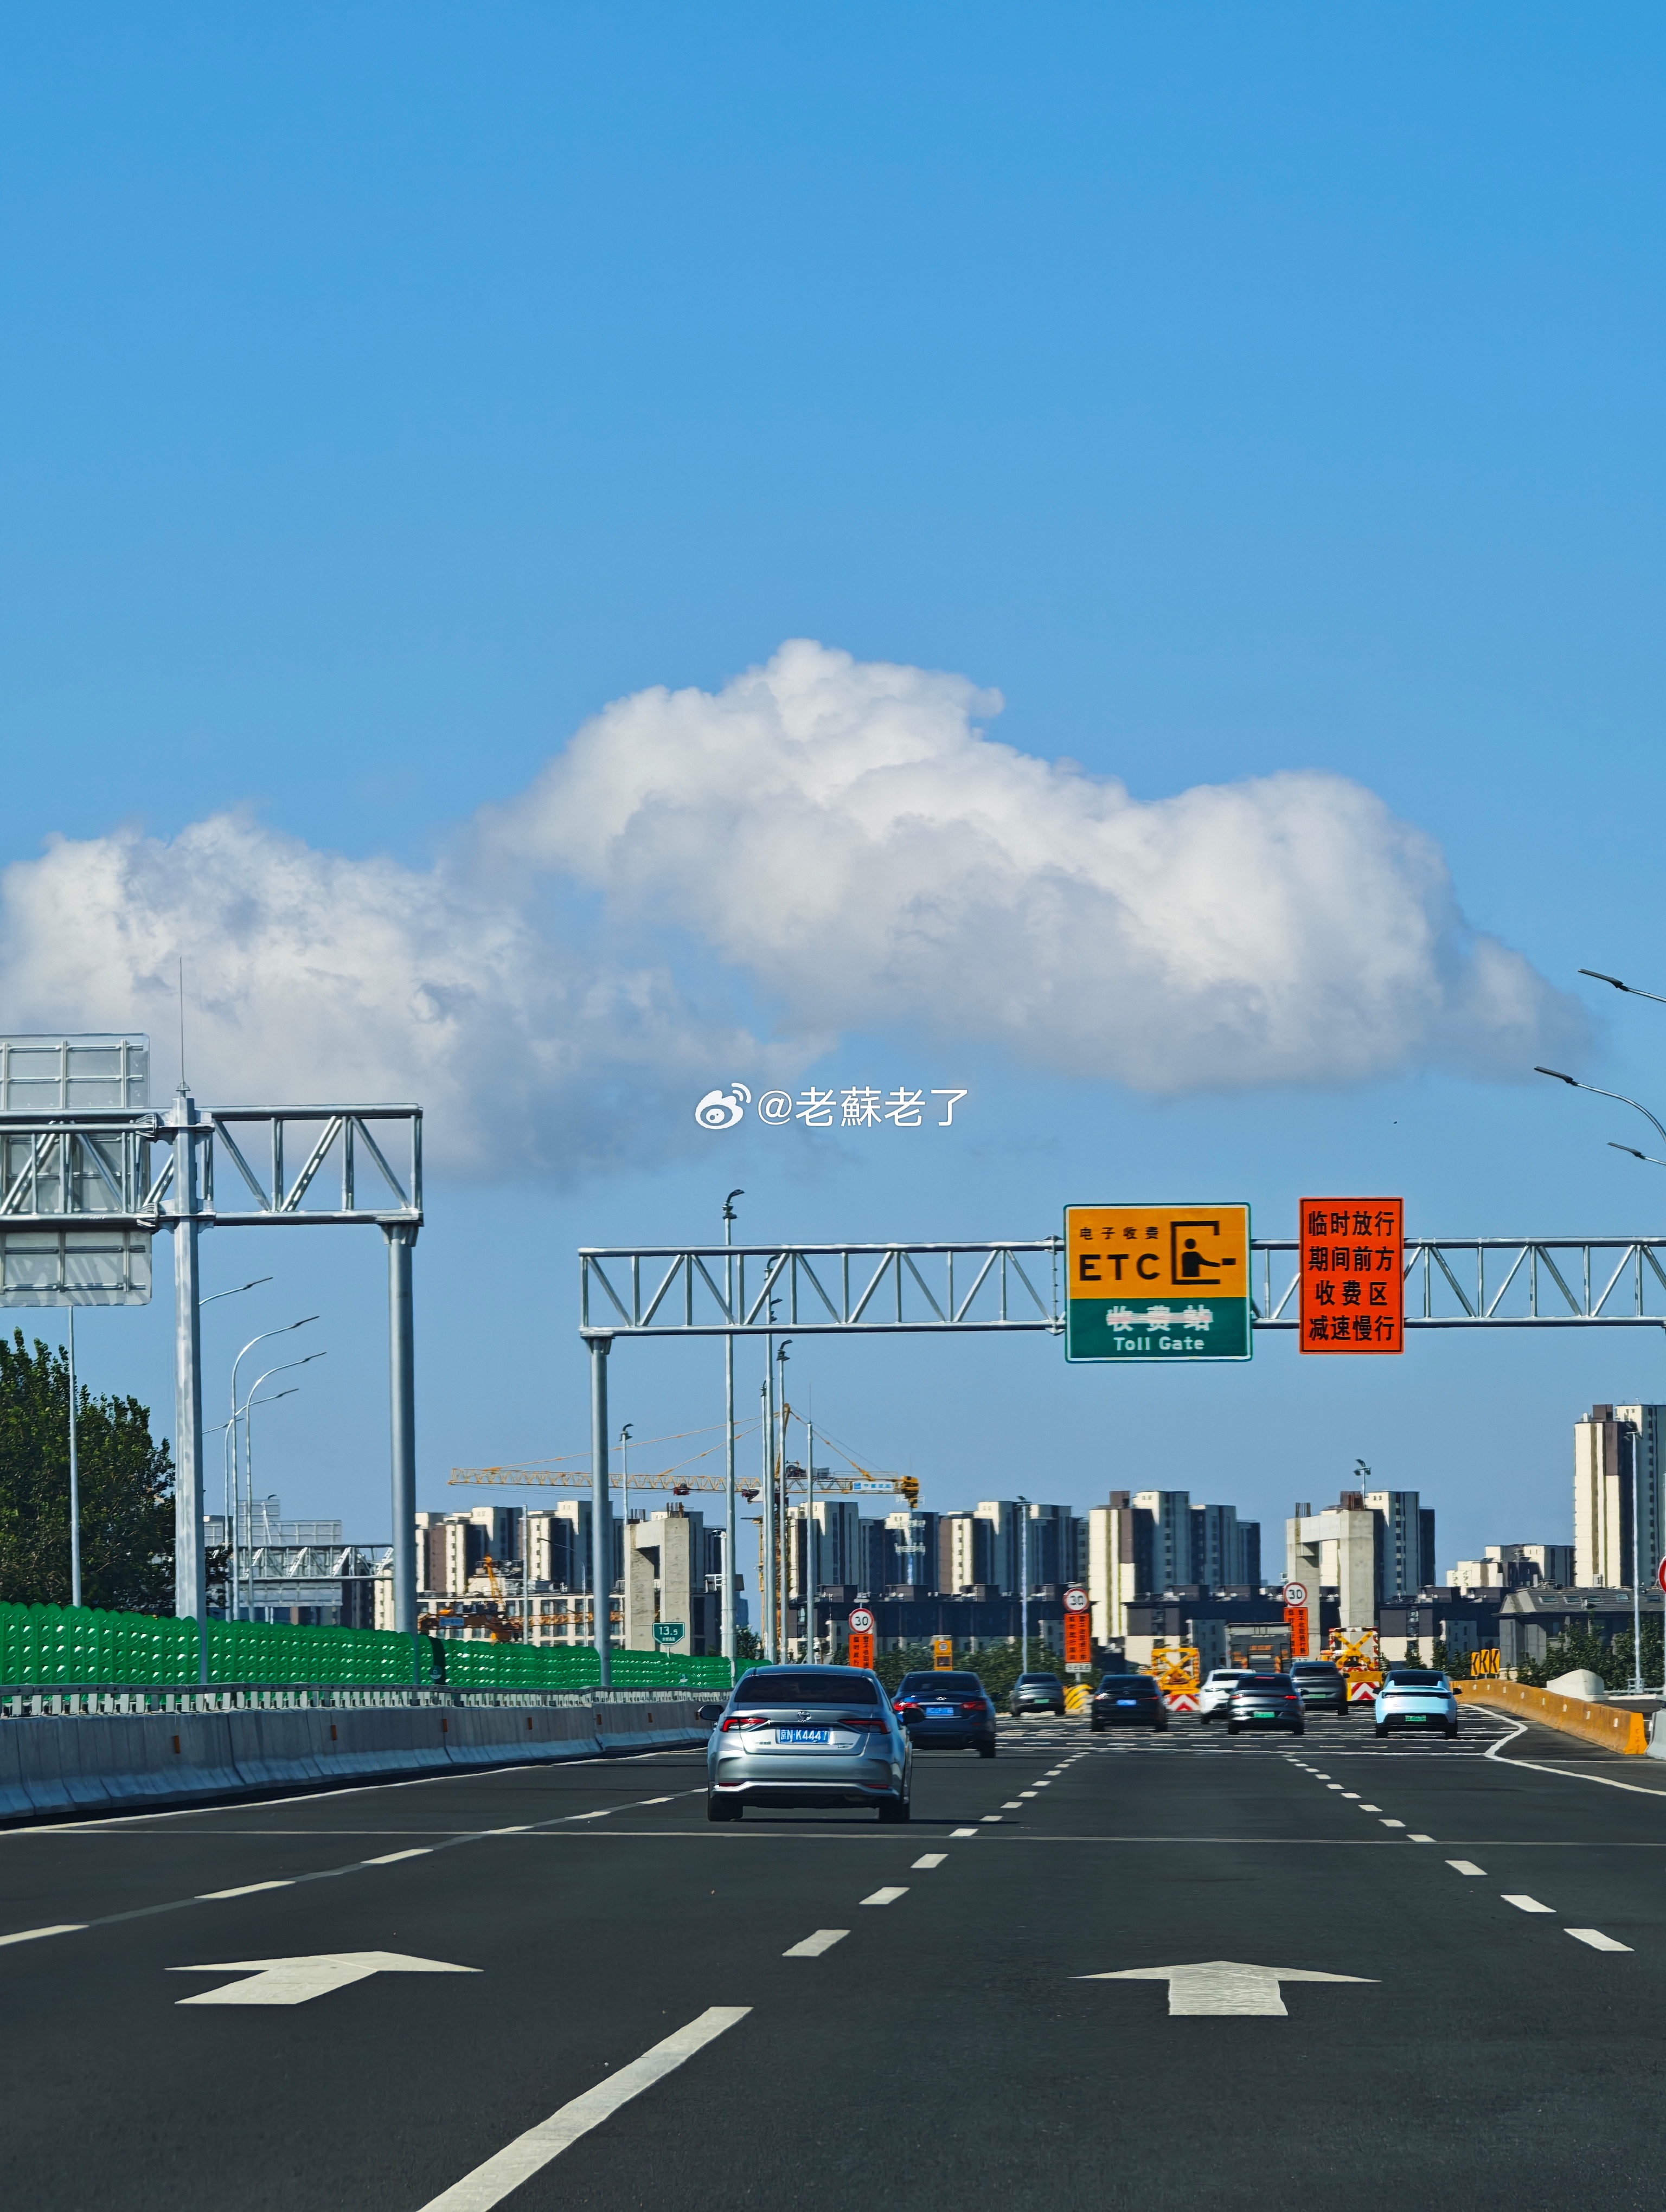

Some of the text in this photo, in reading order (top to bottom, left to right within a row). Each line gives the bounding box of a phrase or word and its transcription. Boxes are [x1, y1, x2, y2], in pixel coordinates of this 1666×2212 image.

[1308, 1210, 1395, 1237] 临时放行
[1079, 1226, 1159, 1240] 电子收费
[1308, 1245, 1395, 1272] 期间前方
[1079, 1253, 1161, 1281] ETC
[1315, 1279, 1388, 1306] 收费区
[1308, 1314, 1395, 1342] 减速慢行
[1113, 1336, 1205, 1351] Toll Gate
[1069, 1594, 1084, 1606] 30
[1288, 1589, 1303, 1600] 30
[854, 1616, 869, 1626] 30
[659, 1626, 678, 1636] 13.5
